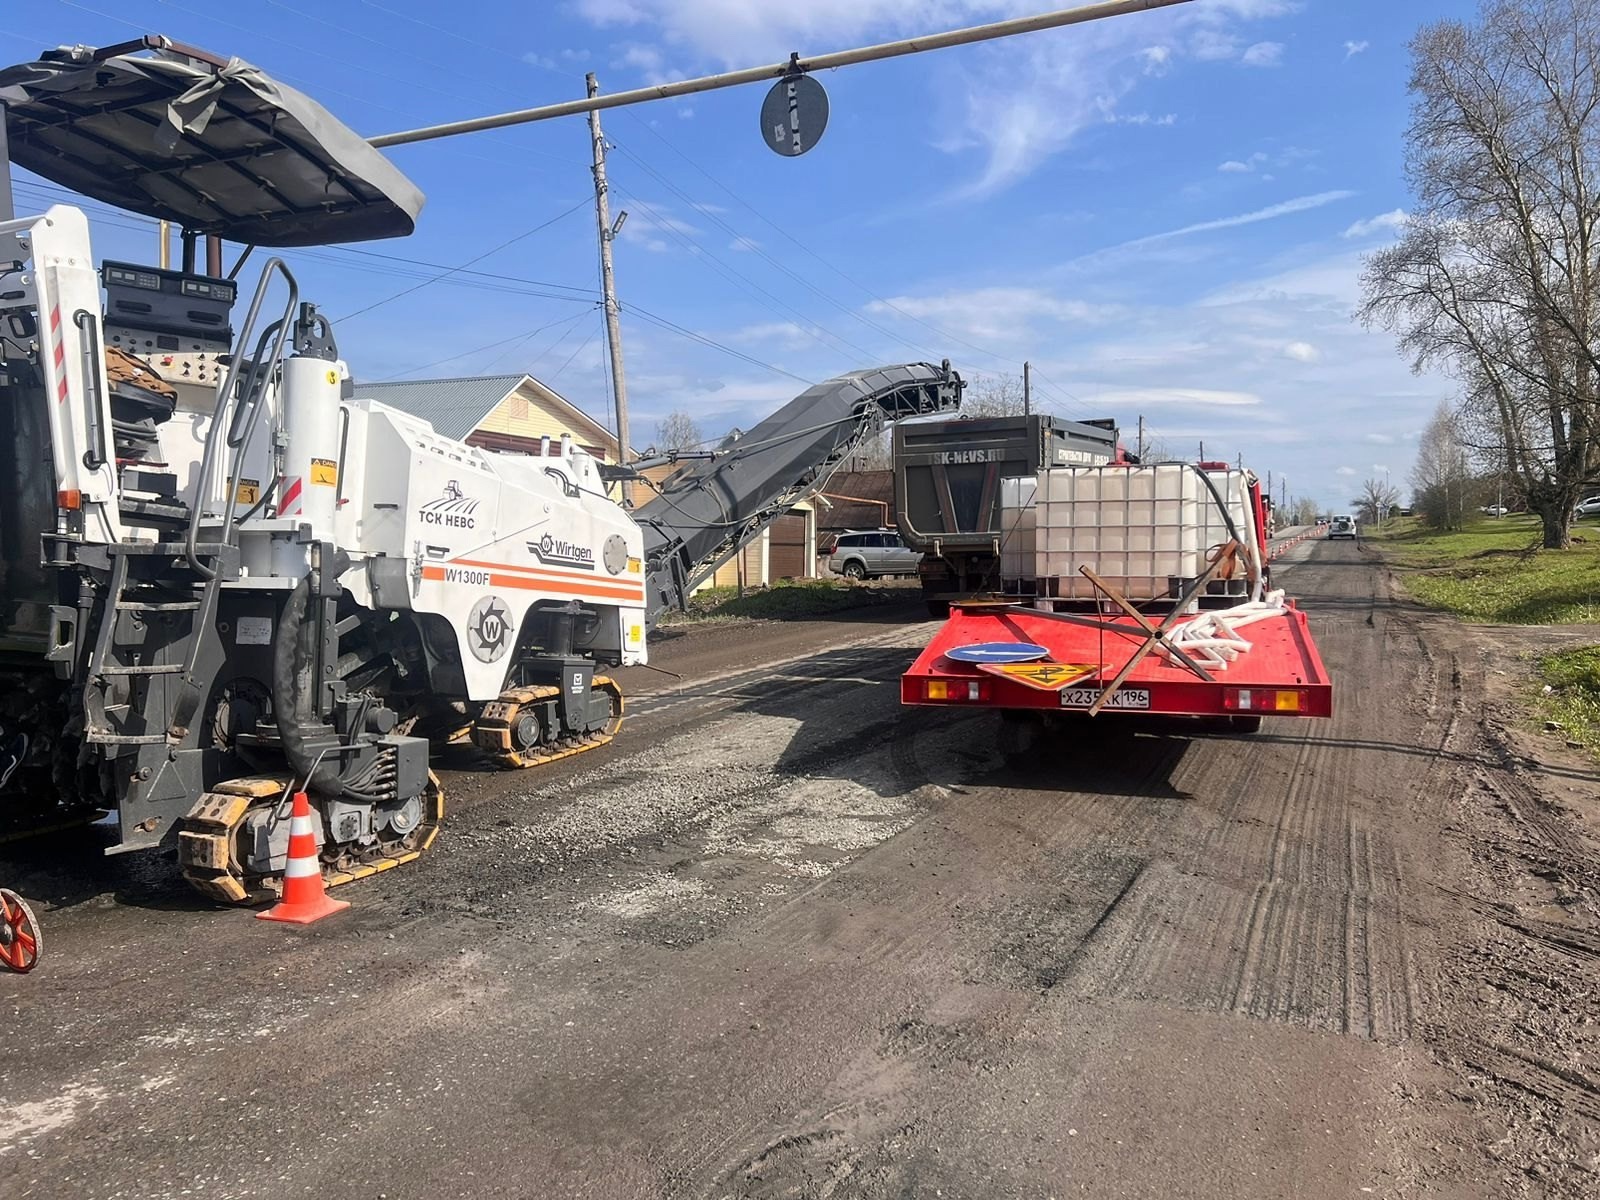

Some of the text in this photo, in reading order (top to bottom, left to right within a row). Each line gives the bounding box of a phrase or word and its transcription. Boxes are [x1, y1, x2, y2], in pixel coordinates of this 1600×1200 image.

[418, 510, 475, 529] ТСК НЕВС
[555, 540, 592, 561] Wirtgen
[445, 568, 490, 586] W1300F
[485, 621, 500, 640] W
[1066, 690, 1146, 706] Х235К 196
